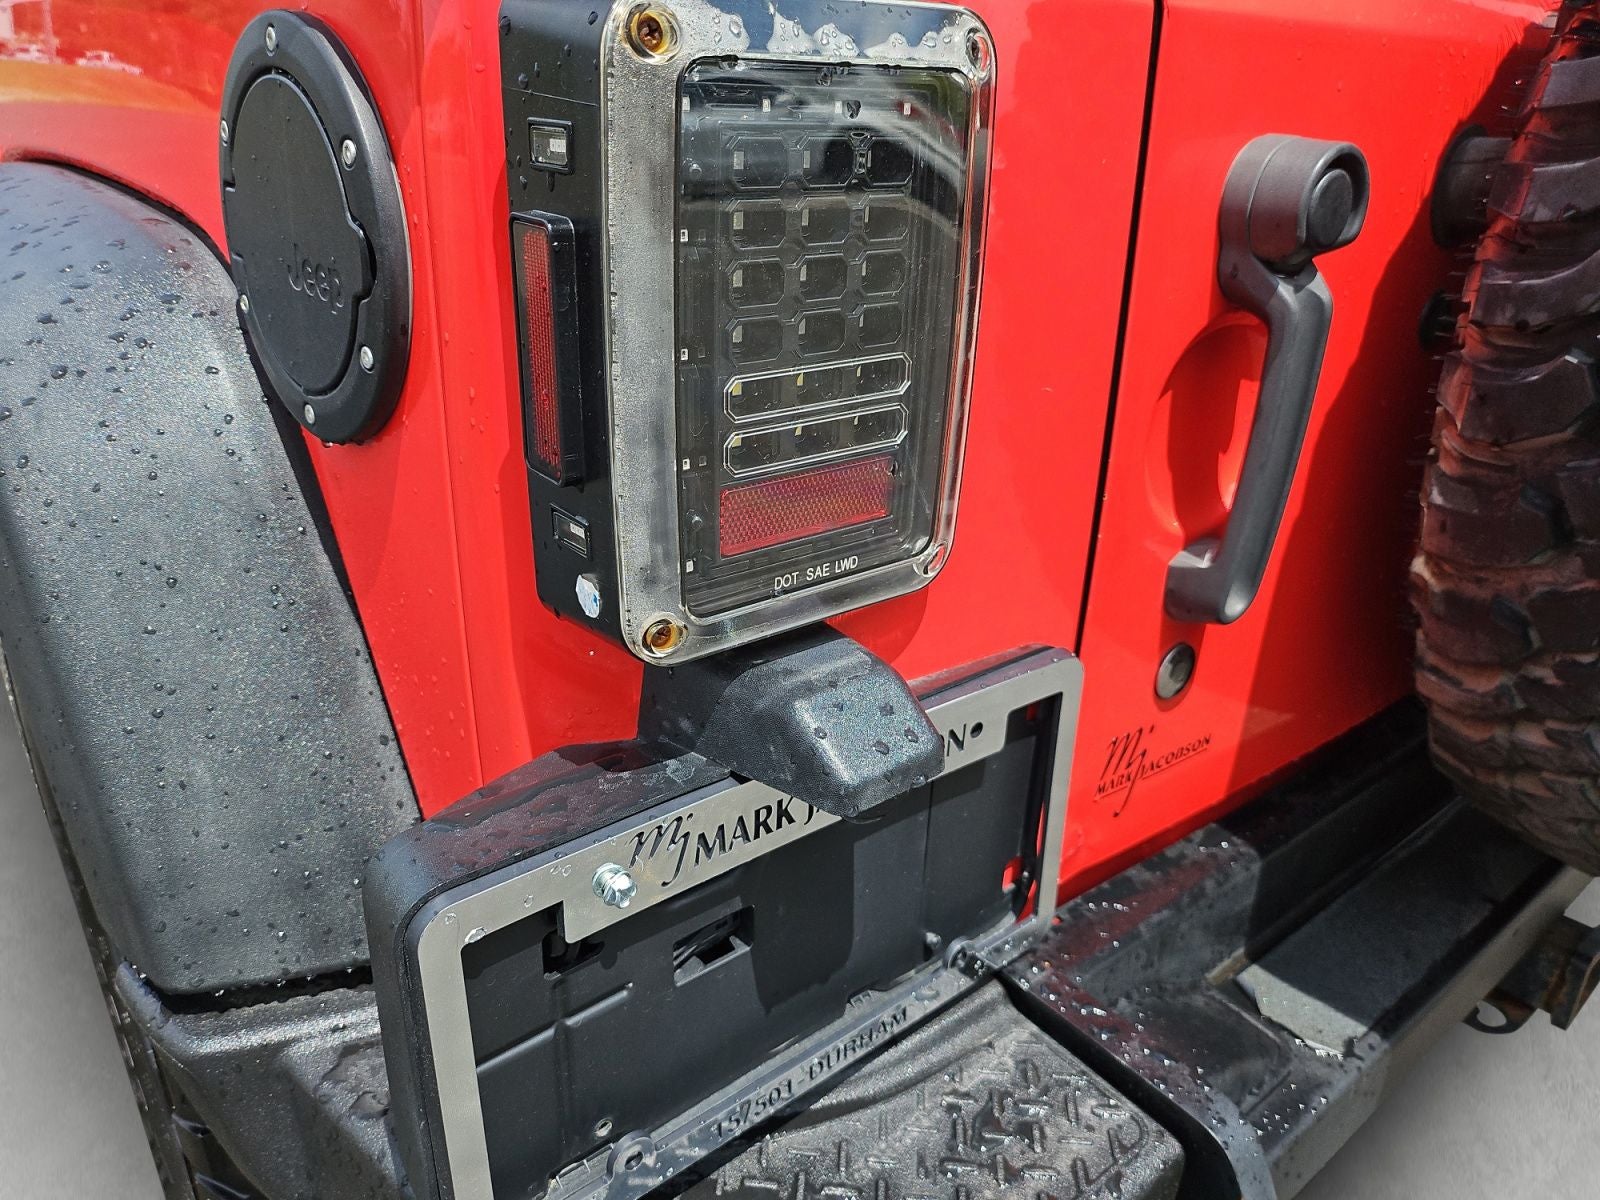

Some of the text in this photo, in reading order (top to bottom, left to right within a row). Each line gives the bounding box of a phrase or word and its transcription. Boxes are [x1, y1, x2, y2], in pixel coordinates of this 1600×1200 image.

[285, 243, 344, 315] Jeep
[774, 555, 859, 590] DOT SAE LWD
[1093, 733, 1211, 797] MARK JACOBSON
[693, 795, 797, 868] MARK
